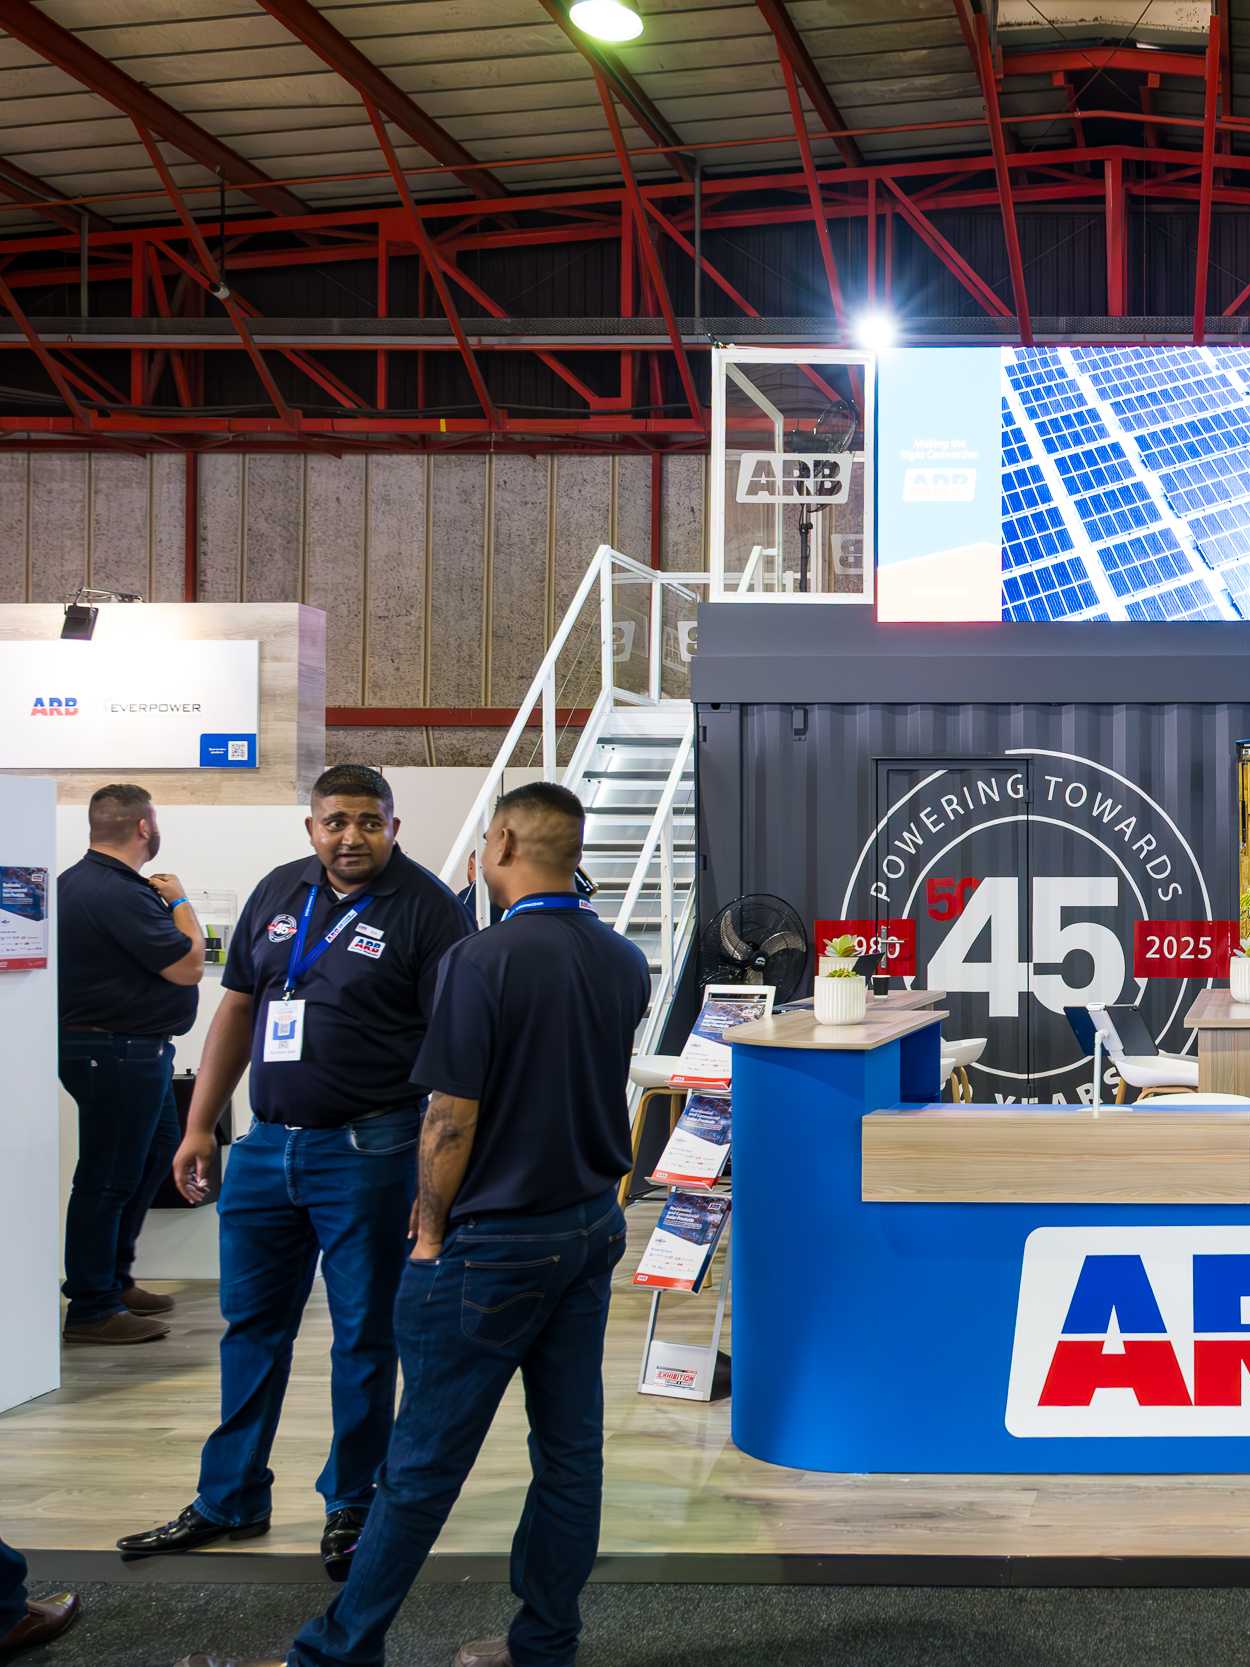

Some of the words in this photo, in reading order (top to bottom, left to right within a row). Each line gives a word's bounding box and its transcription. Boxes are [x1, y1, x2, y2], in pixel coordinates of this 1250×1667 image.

[913, 438, 949, 450] Making
[951, 438, 967, 448] the
[900, 449, 926, 461] Right
[927, 449, 980, 459] Connection
[745, 459, 843, 497] ARB
[910, 473, 970, 496] ARB
[30, 697, 79, 716] ARB
[110, 703, 202, 713] EVERPOWER
[869, 773, 1024, 903] POWERING
[1044, 775, 1183, 901] TOWARDS
[274, 922, 290, 935] 45
[354, 938, 381, 953] ARB
[926, 876, 1126, 1018] 45
[1145, 935, 1212, 959] 2025
[994, 1066, 1120, 1105] YARS
[657, 1371, 696, 1383] EXHIBITION
